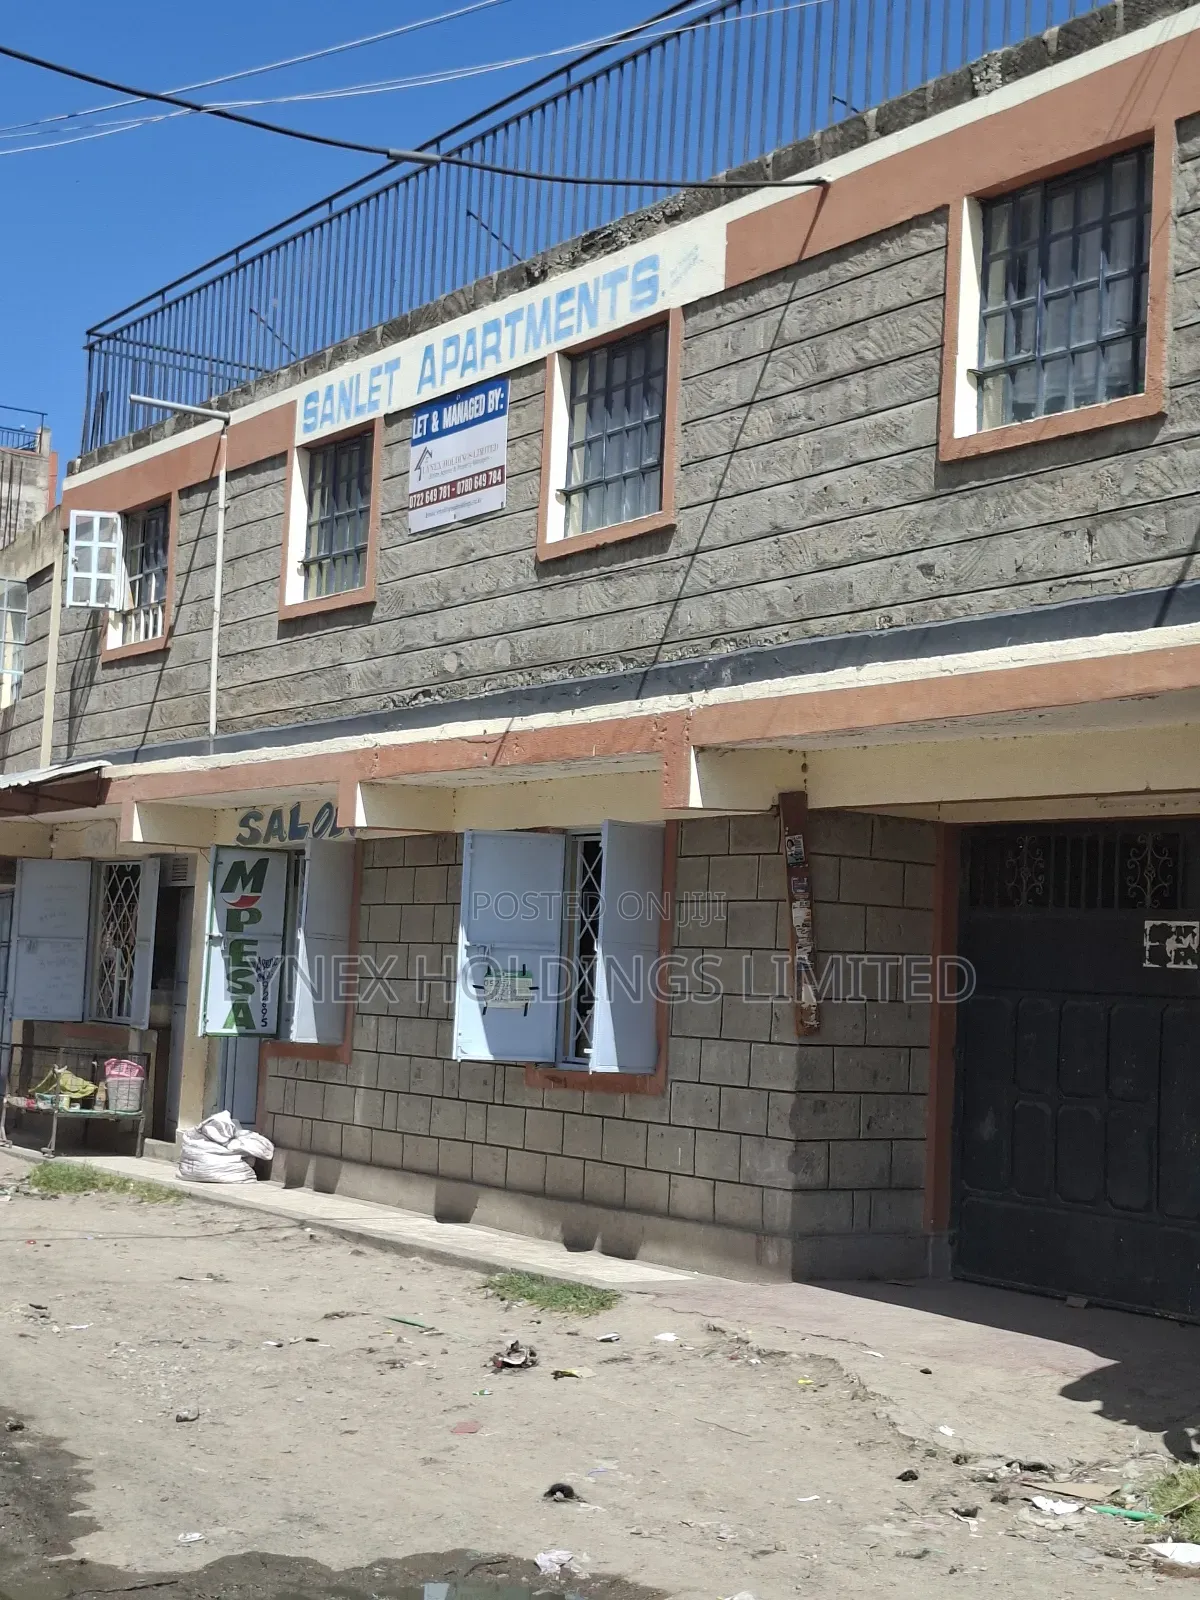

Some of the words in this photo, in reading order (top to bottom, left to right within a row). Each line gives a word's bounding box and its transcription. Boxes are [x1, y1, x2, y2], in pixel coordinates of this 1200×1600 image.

[302, 356, 401, 435] SANLET
[412, 414, 430, 439] LET
[431, 411, 440, 432] &
[442, 394, 486, 429] MANAGED
[487, 387, 505, 413] BY:
[409, 493, 424, 509] 0722
[425, 488, 438, 504] 649
[438, 484, 451, 500] 781
[456, 478, 473, 495] 0780
[474, 473, 487, 490] 649
[488, 468, 502, 485] 784
